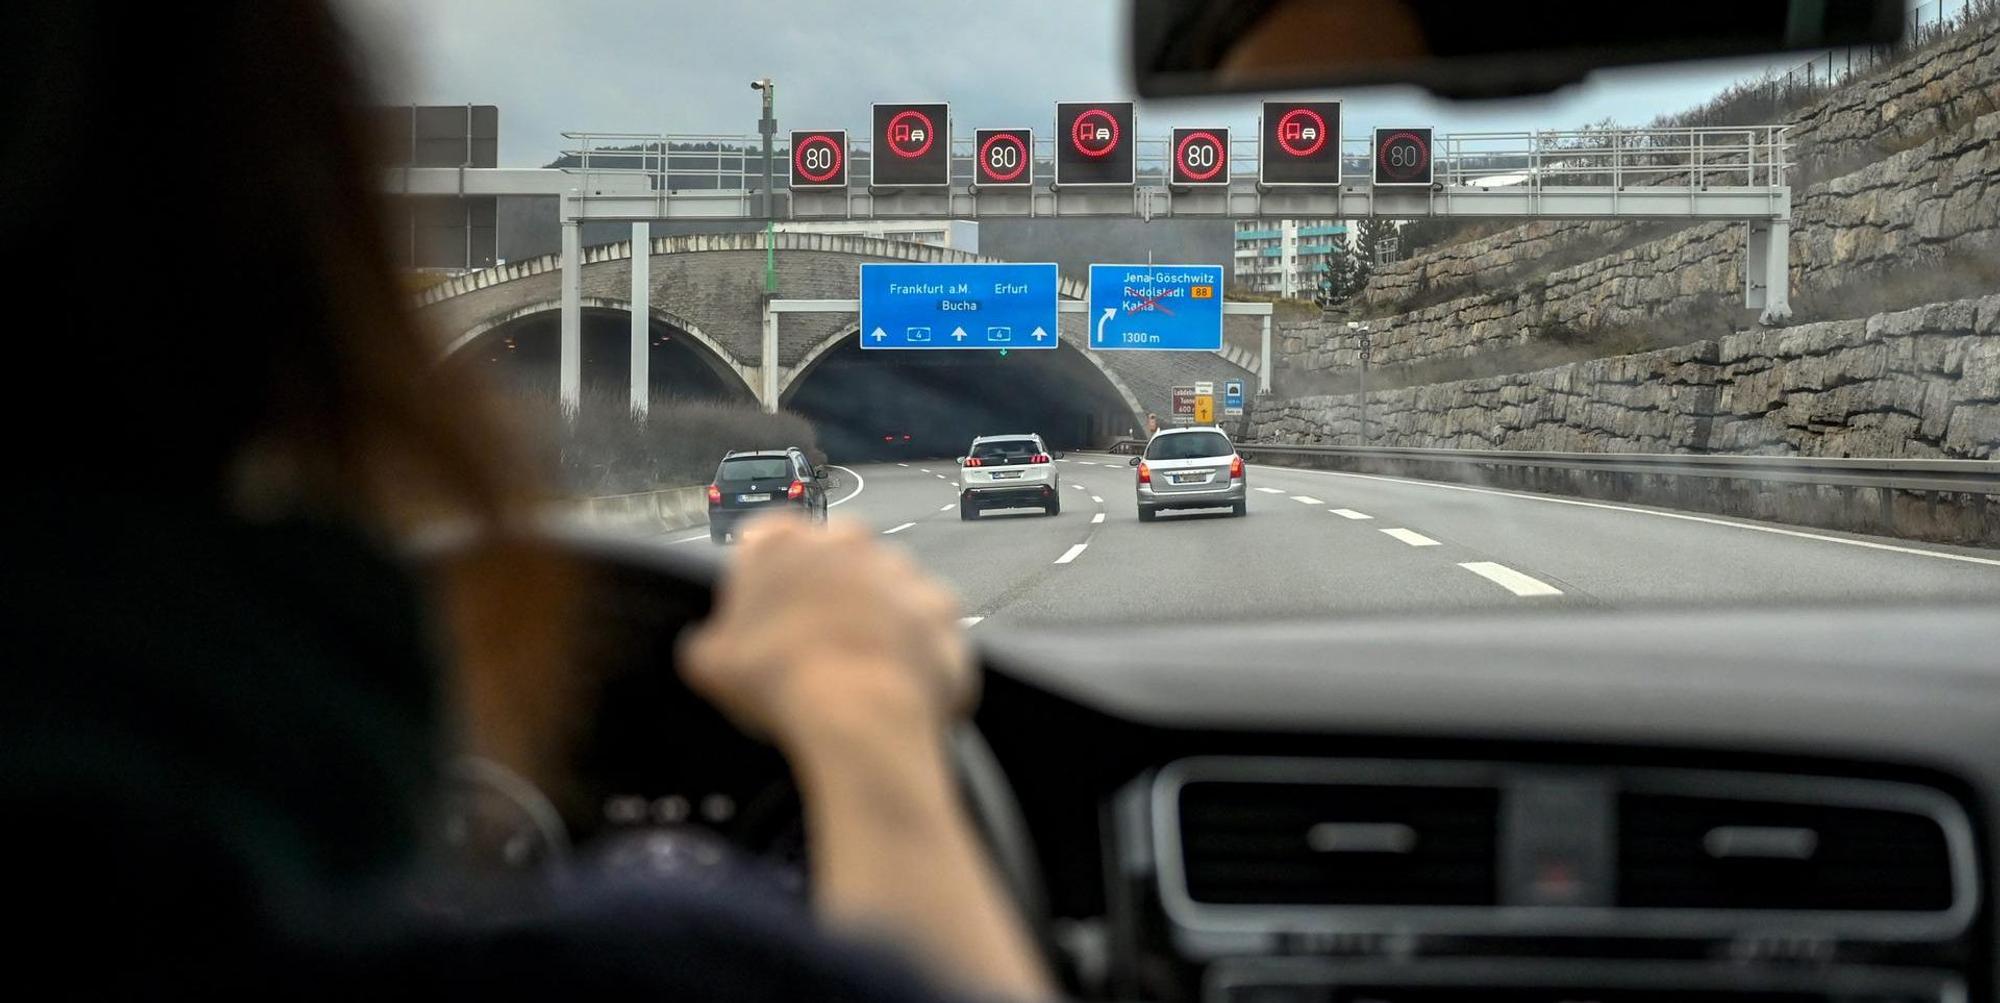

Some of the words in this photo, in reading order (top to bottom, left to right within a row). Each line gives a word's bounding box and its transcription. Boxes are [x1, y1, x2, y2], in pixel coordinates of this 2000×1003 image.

[806, 147, 831, 169] 80
[991, 146, 1016, 168] 80
[1188, 145, 1213, 167] 80
[1391, 145, 1416, 167] 80
[1123, 272, 1214, 283] Jena-Göschwitz
[890, 283, 944, 294] Frankfurt
[994, 283, 1028, 294] Erfurt
[1123, 286, 1185, 297] Rudolstadt
[1195, 287, 1208, 297] 88
[942, 300, 977, 311] Bucha
[1122, 300, 1155, 311] Kahla
[915, 330, 922, 338] 4
[1122, 332, 1147, 343] 1300
[1149, 335, 1160, 343] m
